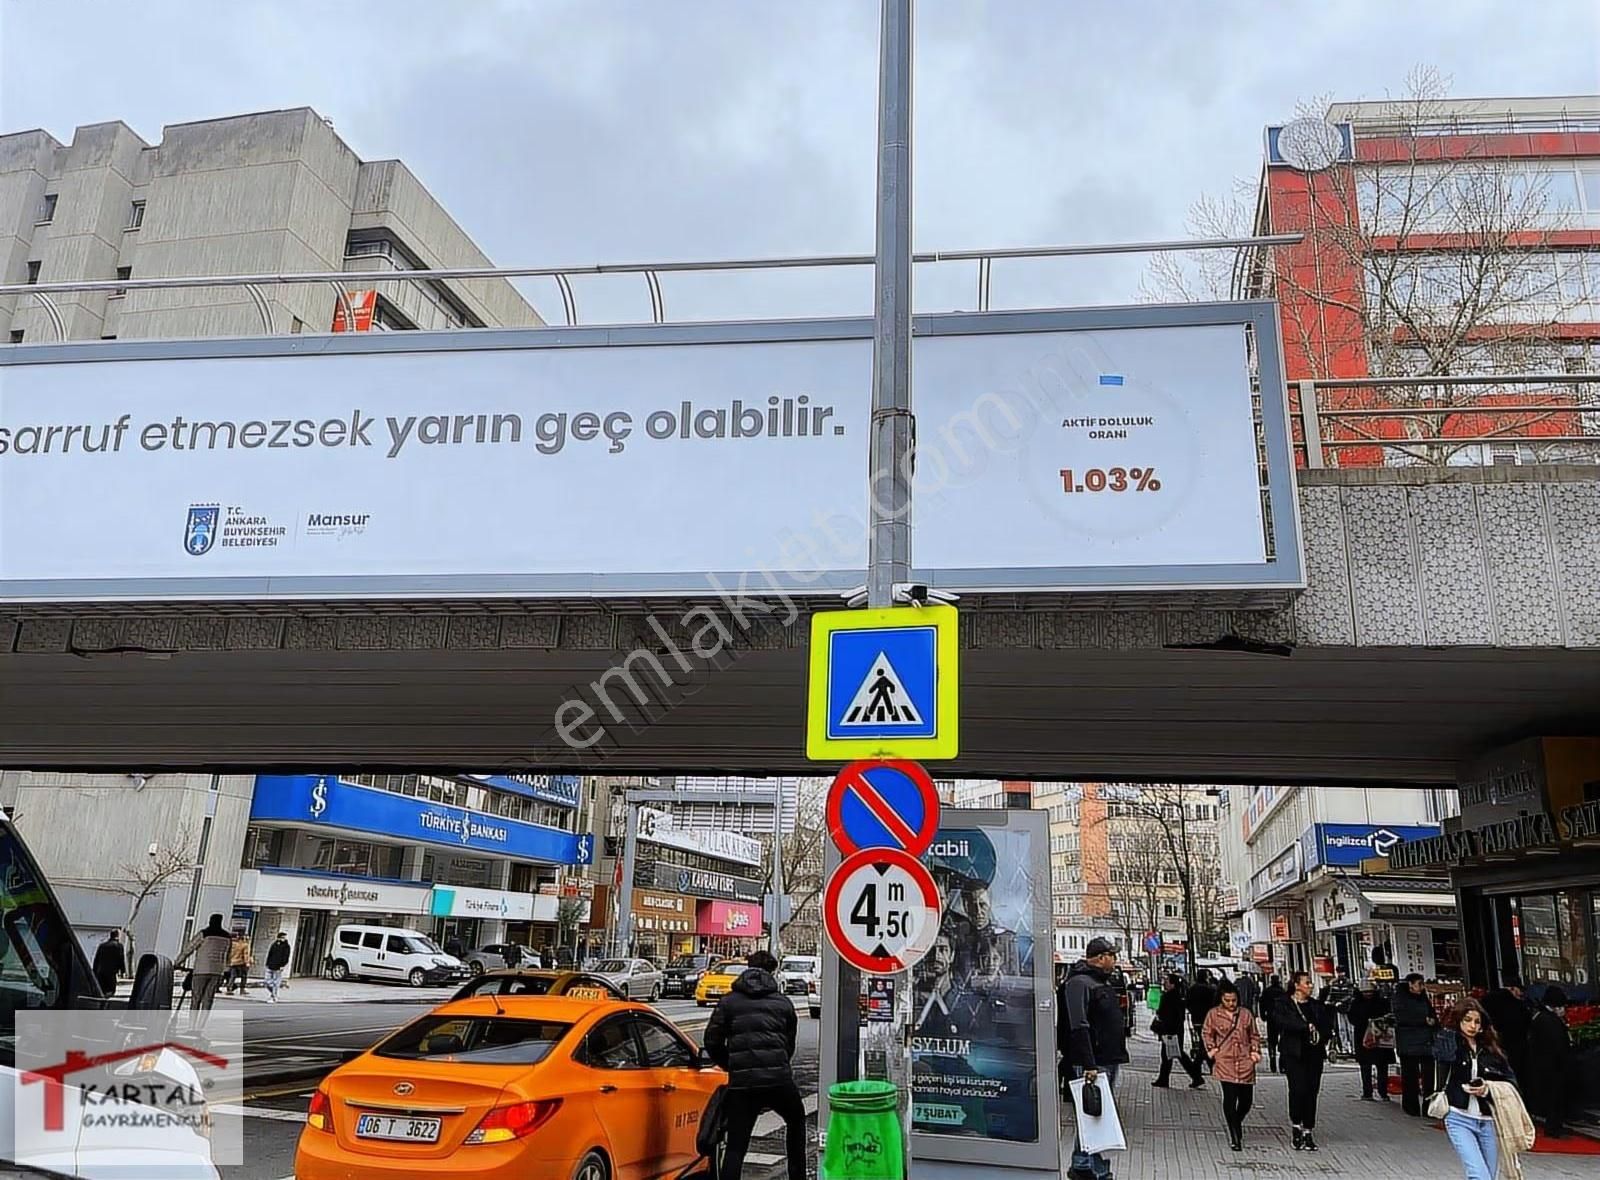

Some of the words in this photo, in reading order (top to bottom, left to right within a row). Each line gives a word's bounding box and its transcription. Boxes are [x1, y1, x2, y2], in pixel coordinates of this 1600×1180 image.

[140, 409, 376, 450] etmezsek
[386, 411, 522, 458] yarın
[535, 410, 633, 455] geç
[645, 395, 846, 440] olabilir.
[1062, 416, 1097, 428] AKTİF
[1099, 416, 1154, 427] DOLULUK
[1088, 430, 1128, 439] ORANI
[1059, 467, 1162, 493] 1.03%
[227, 506, 244, 515] T.C.
[224, 517, 267, 525] ANKARA
[308, 513, 371, 527] Mansur
[420, 812, 460, 833] TÜRKİYE
[470, 823, 507, 842] BANKASI
[888, 883, 904, 901] m
[911, 1037, 971, 1055] SYLUM
[915, 1108, 921, 1116] 7
[923, 1108, 958, 1121] ŞUBAT
[365, 1118, 381, 1133] 06
[387, 1120, 396, 1134] T
[406, 1121, 437, 1138] 3622
